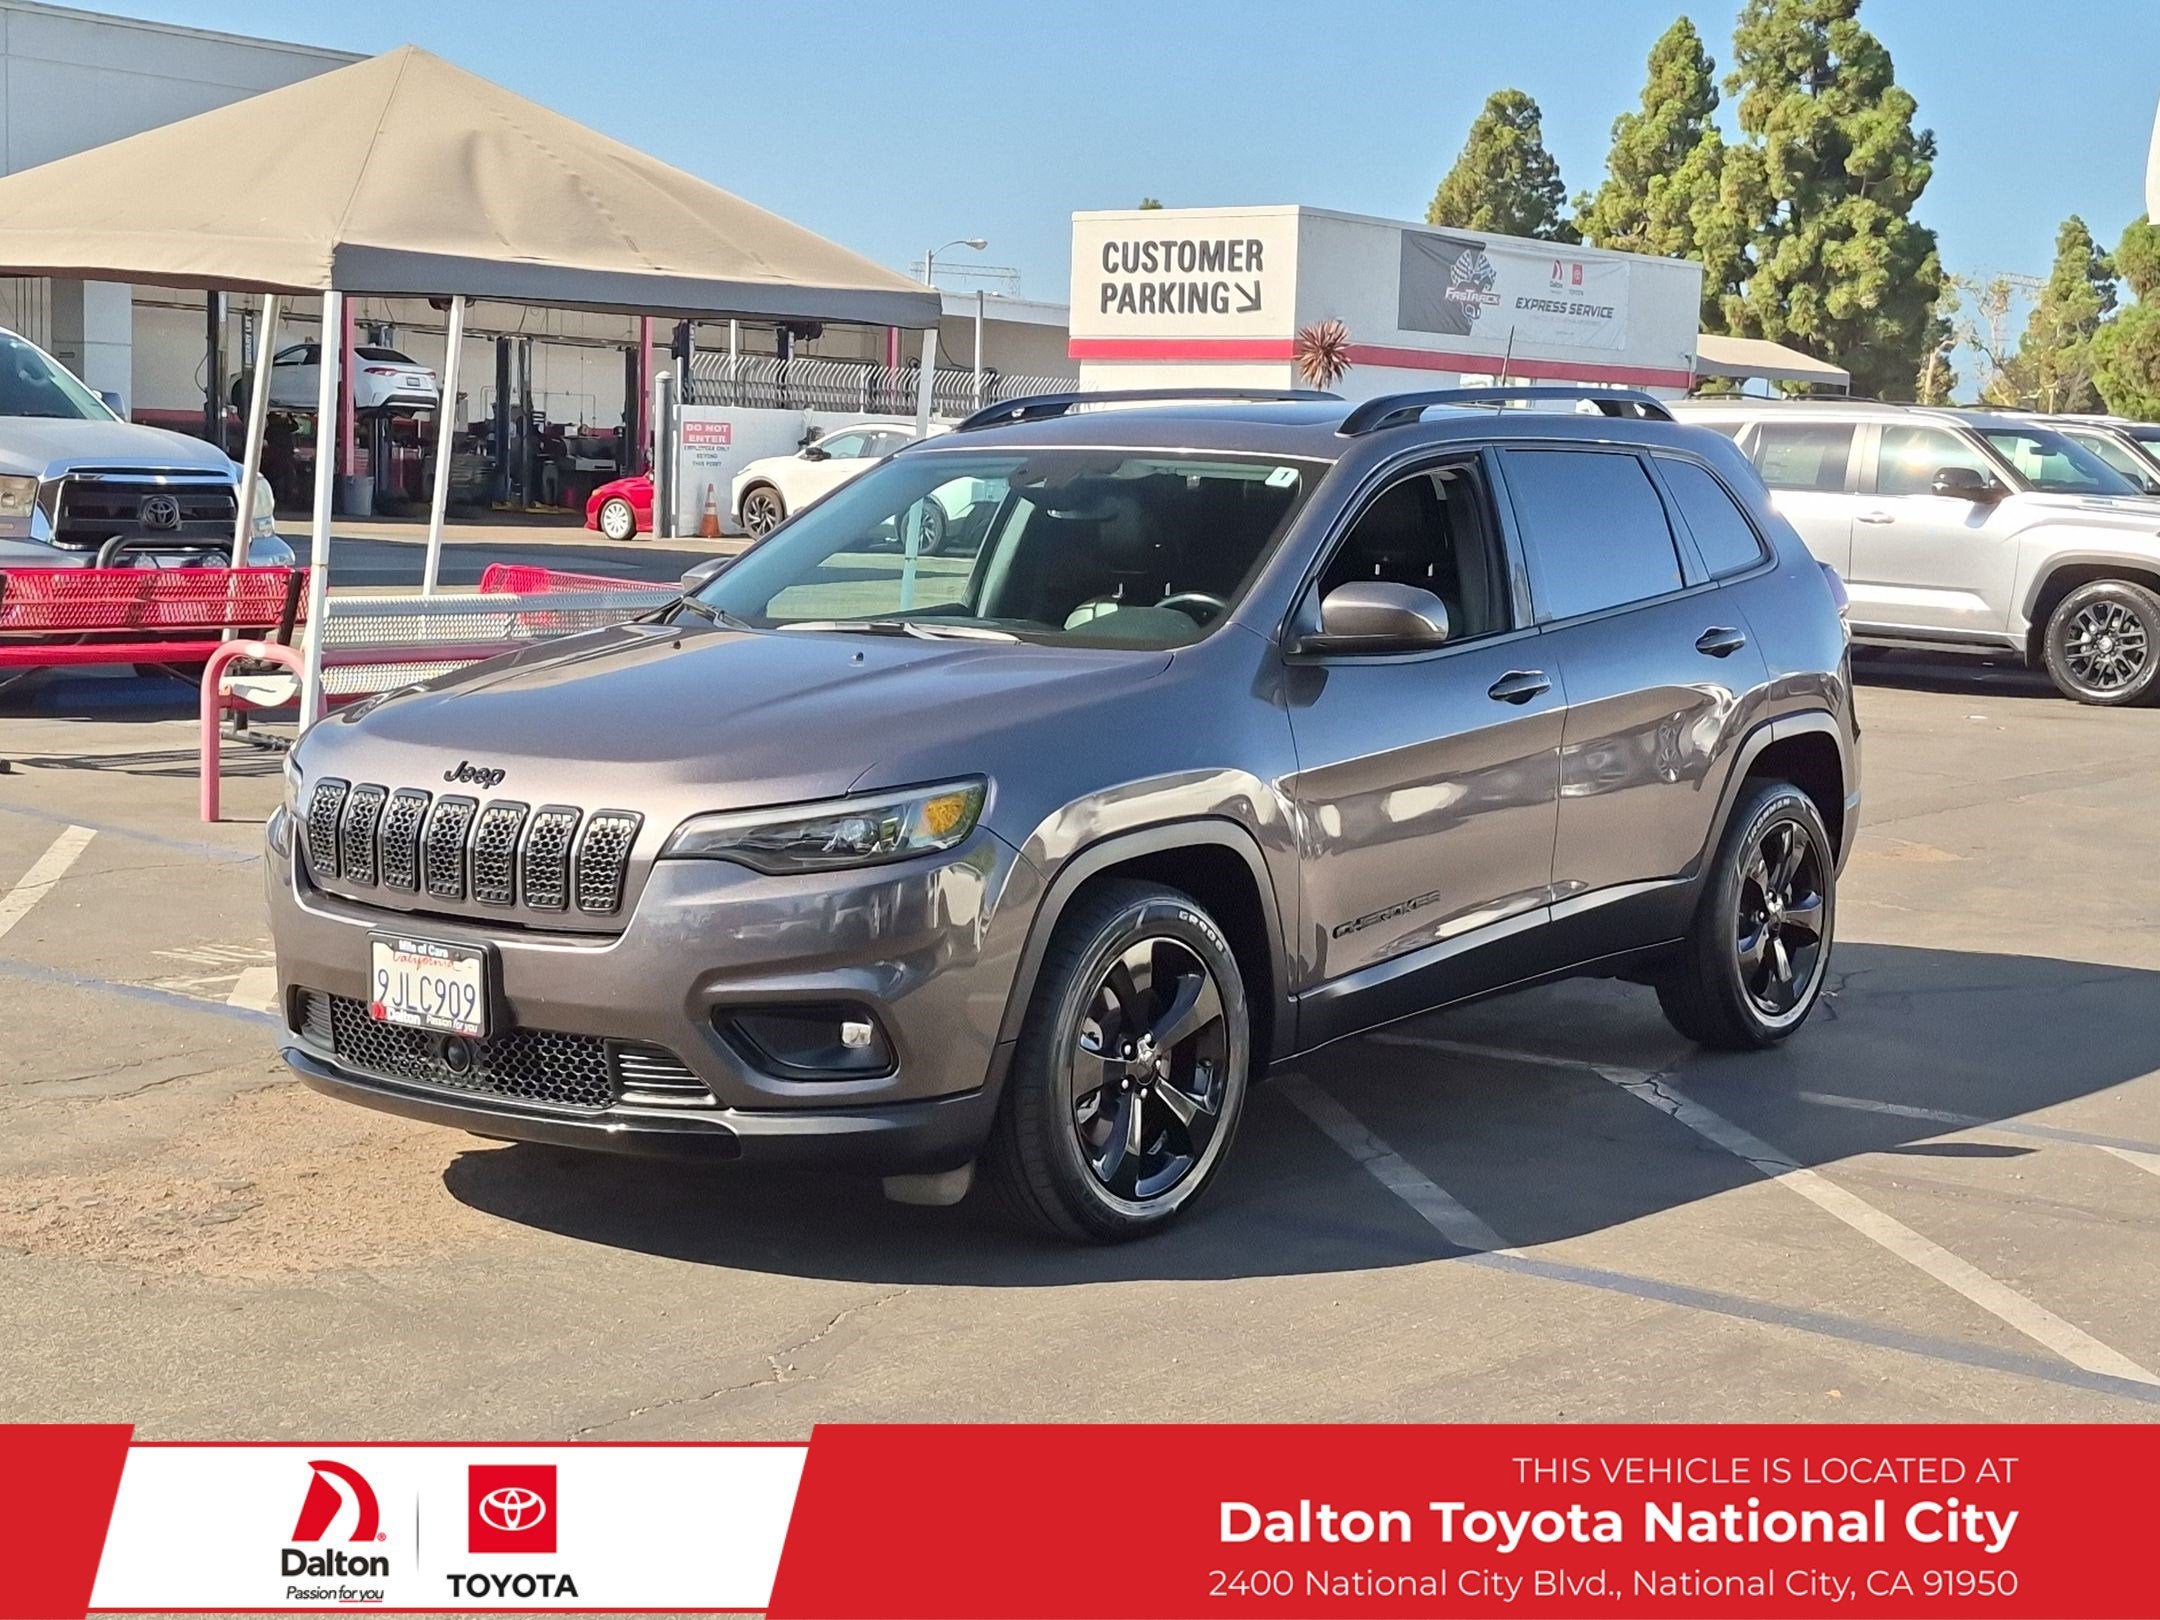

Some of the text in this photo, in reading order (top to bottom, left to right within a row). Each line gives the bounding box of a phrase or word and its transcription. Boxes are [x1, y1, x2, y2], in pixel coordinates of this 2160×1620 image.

[1102, 240, 1264, 273] CUSTOMER
[1100, 281, 1230, 314] PARKING
[1515, 297, 1614, 319] EXPRESS SERVICE
[686, 423, 729, 433] DO NOT
[688, 434, 726, 443] ENTER
[443, 760, 506, 790] Jeep
[1331, 889, 1440, 940] CHEROKEE
[398, 939, 449, 958] Mile of Cars
[377, 968, 476, 1021] 9JLC909
[388, 1007, 478, 1033] Dalton Passion for you
